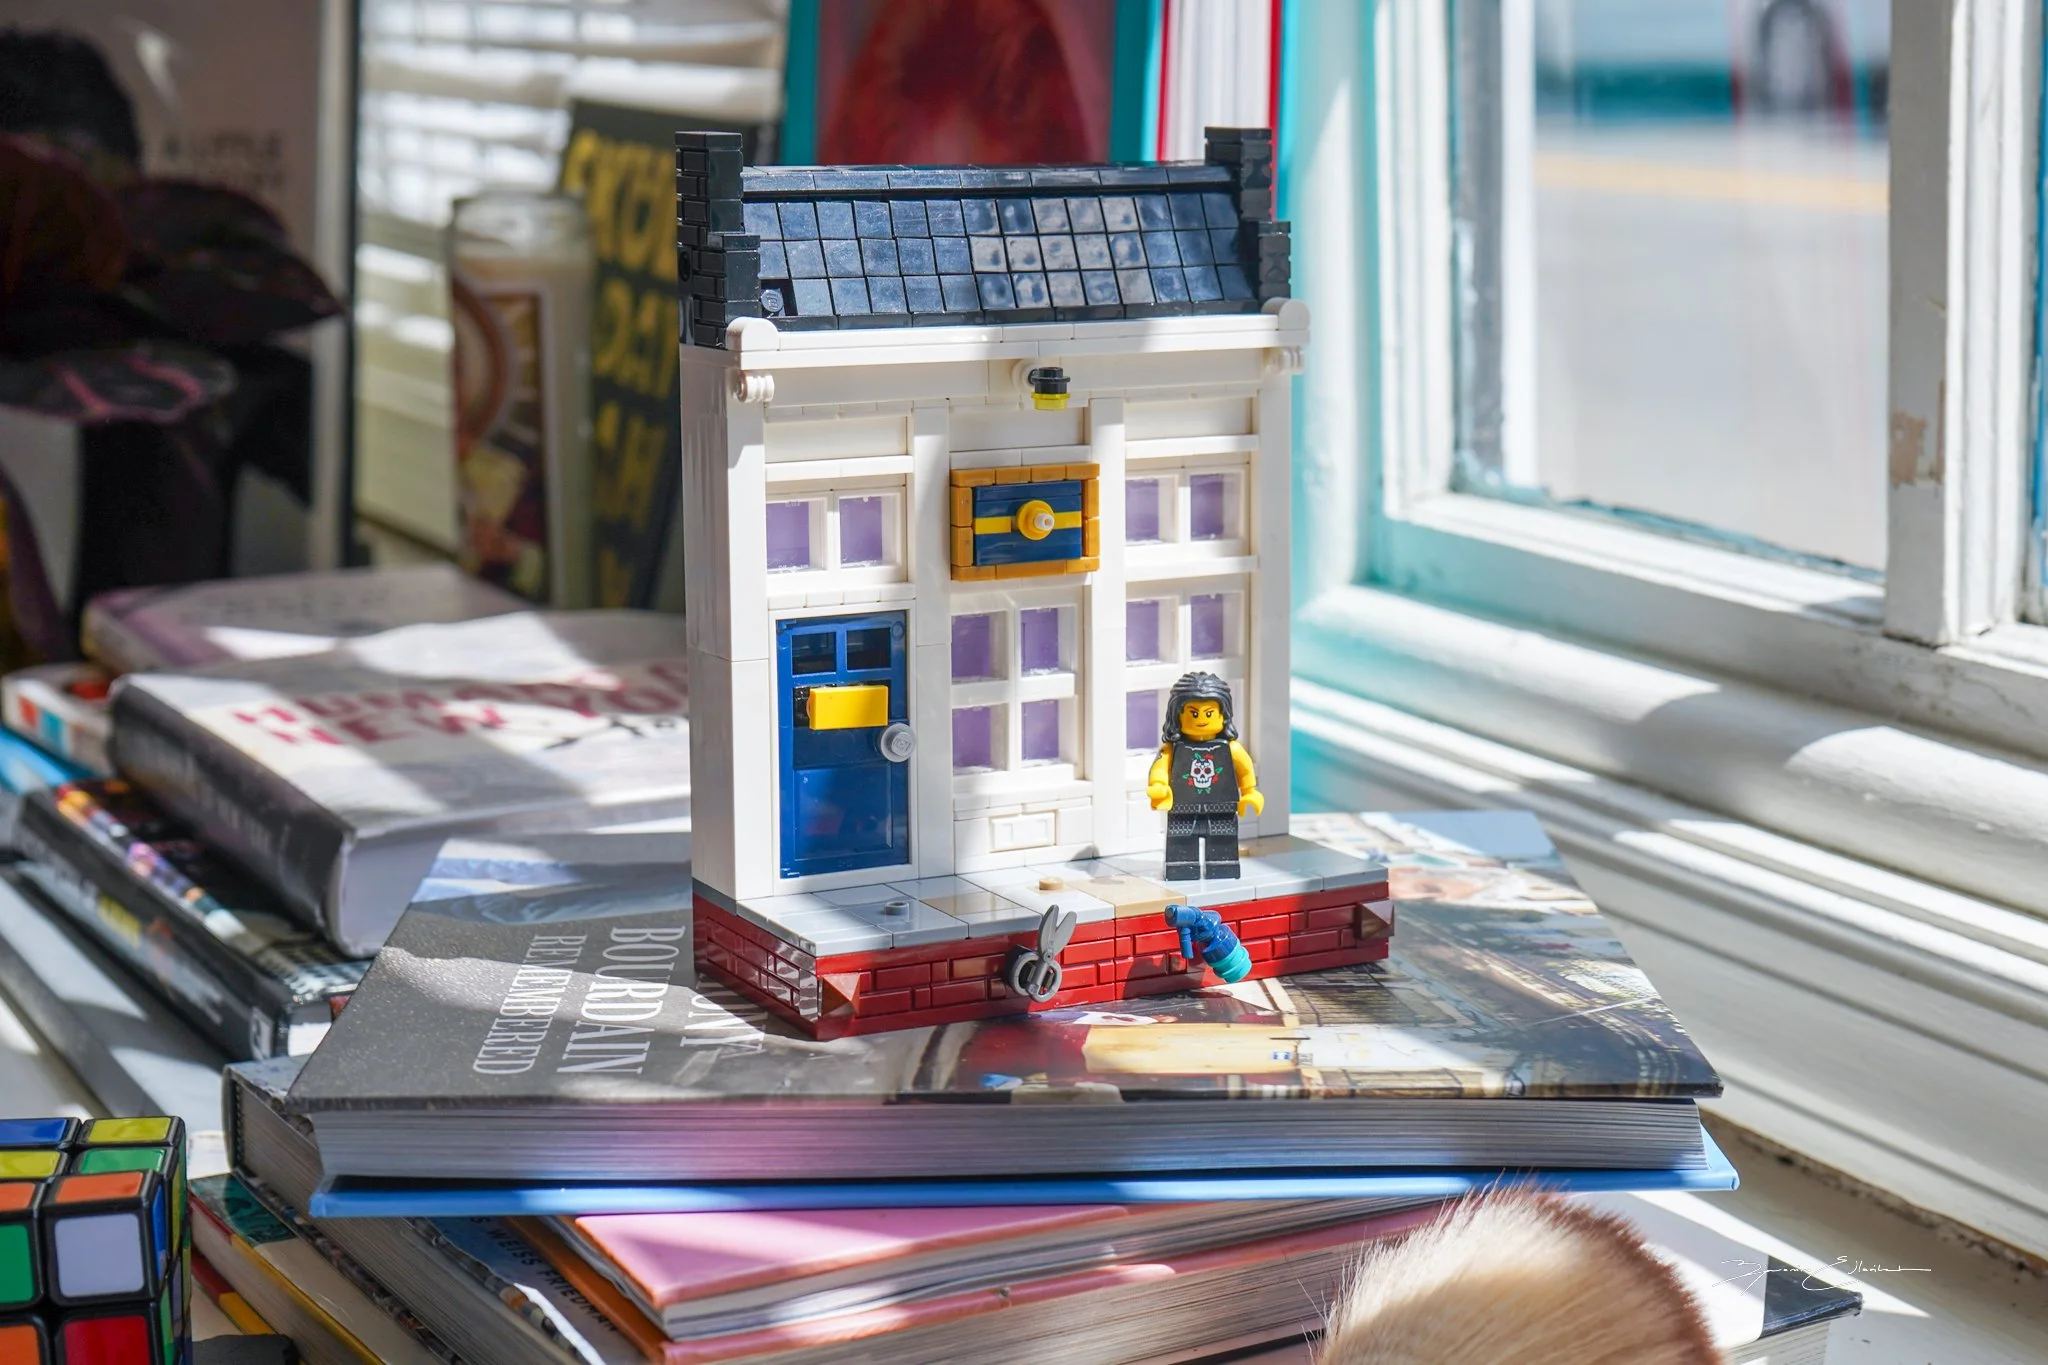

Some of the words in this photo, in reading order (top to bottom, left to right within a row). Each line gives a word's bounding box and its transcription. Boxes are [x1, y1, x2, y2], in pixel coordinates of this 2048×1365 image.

[472, 933, 588, 1075] REMEMBERED
[556, 925, 686, 1075] BOURDAIN
[486, 1228, 542, 1267] WEISS
[536, 1269, 621, 1333] FRIEDMAN
